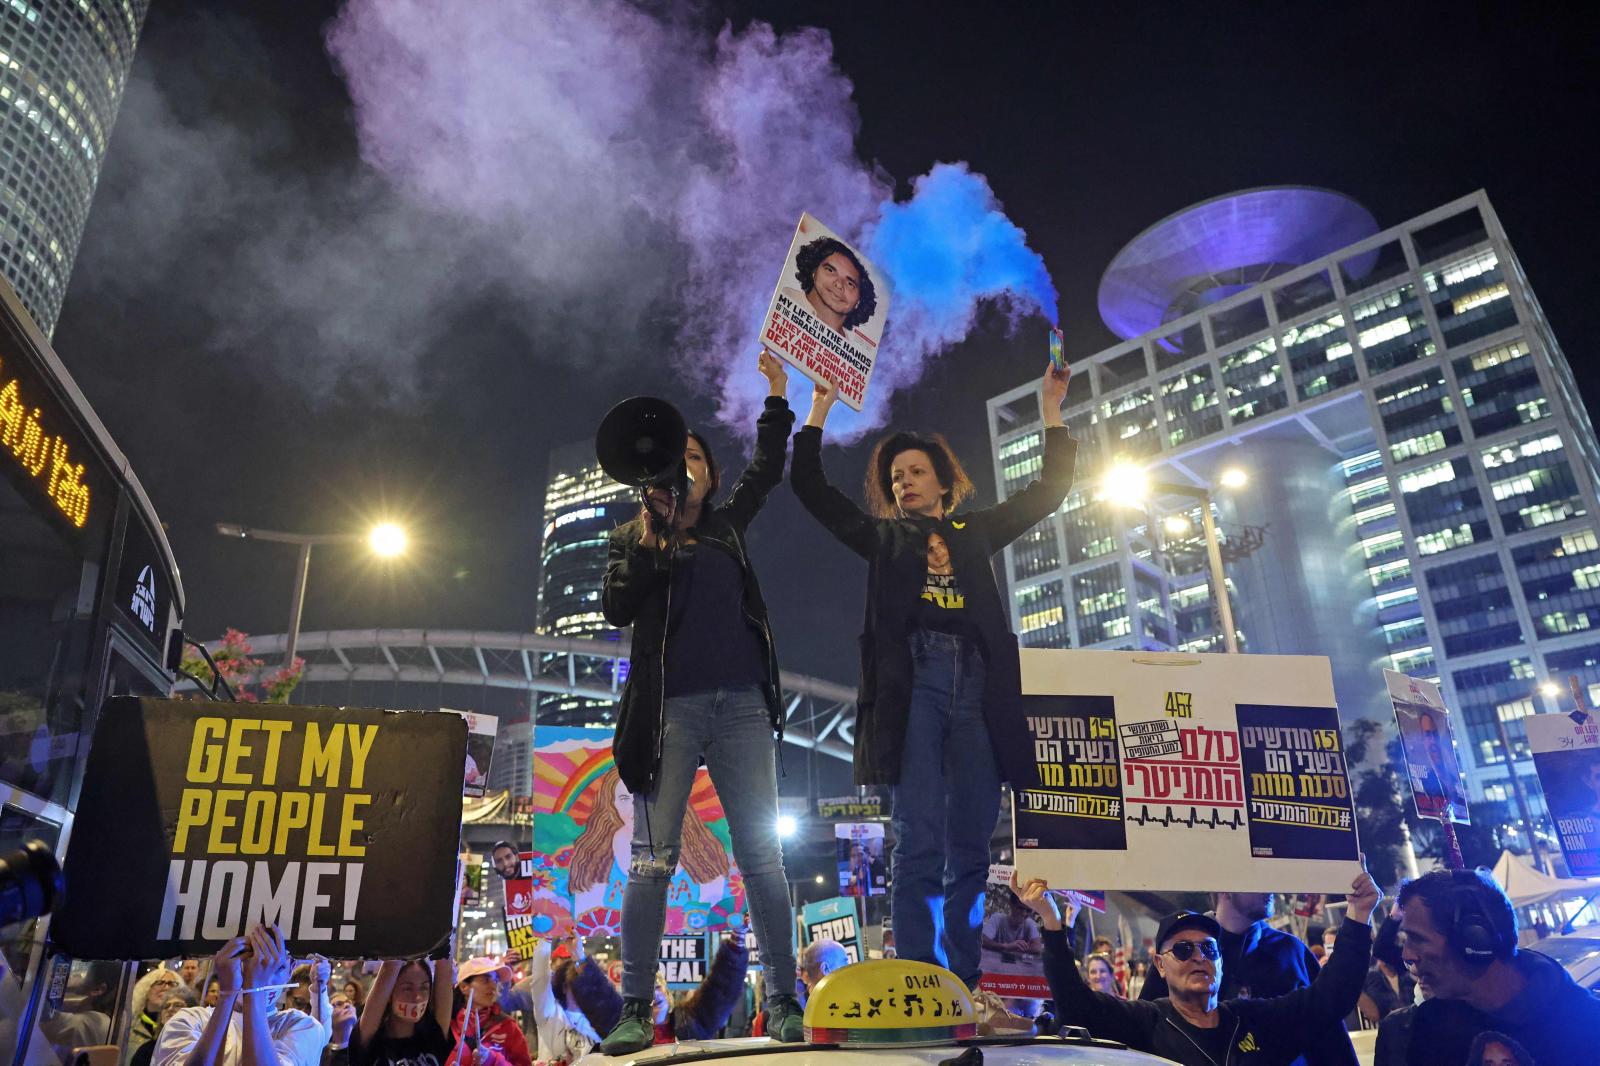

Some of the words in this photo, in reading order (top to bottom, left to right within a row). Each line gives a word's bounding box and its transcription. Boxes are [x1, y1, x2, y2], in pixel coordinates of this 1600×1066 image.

[778, 294, 793, 308] MY
[793, 305, 813, 324] LIFE
[812, 319, 820, 330] IS
[826, 328, 843, 346] THE
[843, 342, 872, 367] HANDS
[782, 307, 791, 318] THE
[791, 314, 820, 339] ISRAELI
[820, 336, 870, 375] GOVERNMENT
[771, 319, 795, 341] THEY
[795, 339, 814, 357] ARE
[815, 353, 850, 382] SIGNING
[851, 378, 865, 392] MY
[772, 312, 781, 320] IF
[782, 317, 801, 336] THEY
[801, 333, 824, 351] DON'T
[823, 349, 840, 365] SIGN
[840, 362, 847, 370] A
[847, 366, 866, 385] DEAL
[766, 328, 804, 361] DEATH
[806, 357, 863, 404] WARANT!
[1165, 692, 1192, 718] 467
[1026, 717, 1086, 739] חודשי
[1128, 724, 1149, 735] ואנשי
[1150, 721, 1170, 732] נשות
[1242, 726, 1313, 749] חודשים
[1035, 740, 1063, 762] הם
[1067, 741, 1117, 763] בשבי
[1129, 744, 1161, 758] החטופים
[1160, 742, 1179, 755] למען
[1180, 725, 1240, 763] כולם
[1313, 730, 1339, 751] 15
[186, 717, 292, 785] GET
[299, 722, 379, 788] MY
[1264, 750, 1292, 773] הם
[1295, 751, 1344, 775] בשבי
[1038, 764, 1064, 787] מו
[1069, 764, 1118, 787] סכנת
[1124, 764, 1243, 802] הומניטרי
[1251, 773, 1296, 797] מוות
[1299, 774, 1347, 799] סכנת
[172, 789, 371, 857] PEOPLE
[1557, 818, 1593, 836] BRING
[1563, 834, 1587, 851] HIM
[156, 860, 365, 940] HOME!
[660, 939, 696, 959] THE
